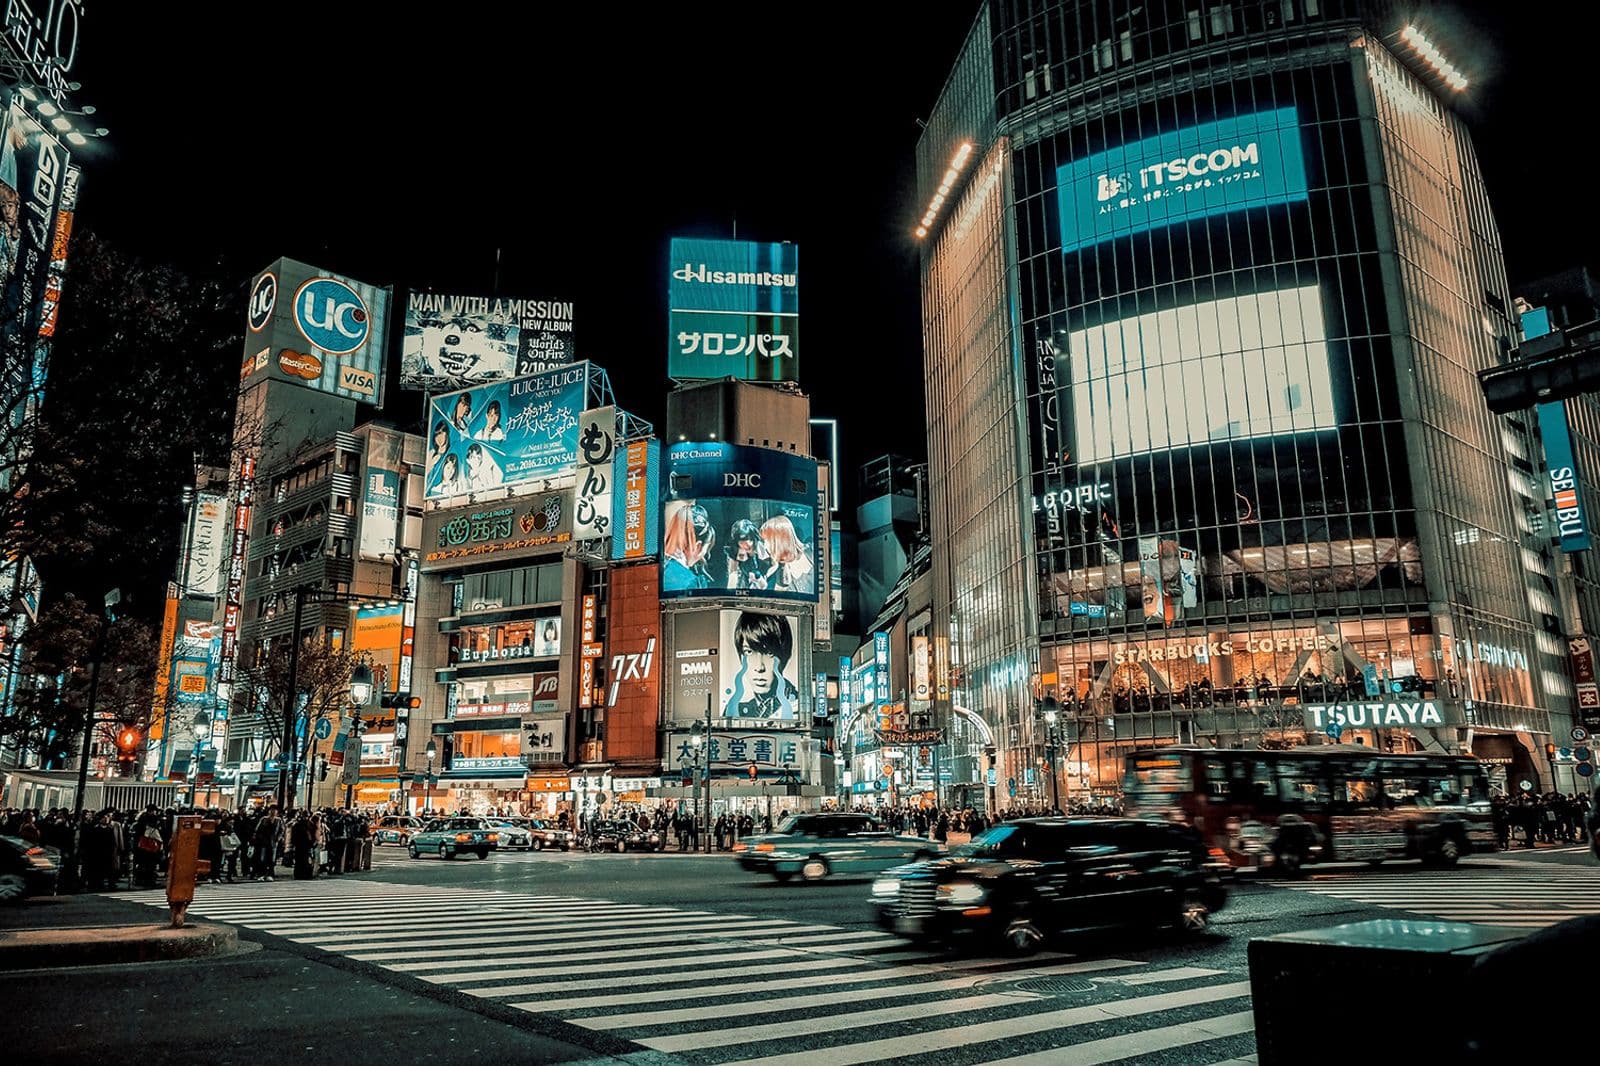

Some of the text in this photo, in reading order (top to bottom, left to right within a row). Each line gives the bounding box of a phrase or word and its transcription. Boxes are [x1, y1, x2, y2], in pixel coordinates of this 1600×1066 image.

[1139, 142, 1260, 188] ITSCOM
[673, 264, 796, 287] Hisamitsu
[304, 291, 364, 339] UC
[409, 293, 574, 320] MAN WITH A MISSION
[522, 319, 573, 332] NEW ALBUM
[528, 339, 565, 350] World's
[677, 332, 793, 359] サロンパス
[279, 356, 322, 374] MasterCard
[344, 373, 374, 390] VISA
[548, 455, 561, 465] ON
[561, 452, 576, 463] SAL
[671, 449, 722, 460] DHC Channel
[577, 422, 612, 533] もんじゃ
[723, 473, 761, 488] DHC
[626, 447, 642, 550] 三千里薬品
[1550, 466, 1583, 537] SEIBU
[471, 516, 513, 542] 西村
[462, 644, 531, 662] Euphoria
[1115, 635, 1328, 665] STARBUCKS COFFEE
[680, 661, 713, 675] DMM
[535, 677, 558, 696] JTB
[680, 674, 713, 686] mobile
[1308, 702, 1443, 728] TSUTAYA
[676, 739, 797, 763] 大盛堂書店
